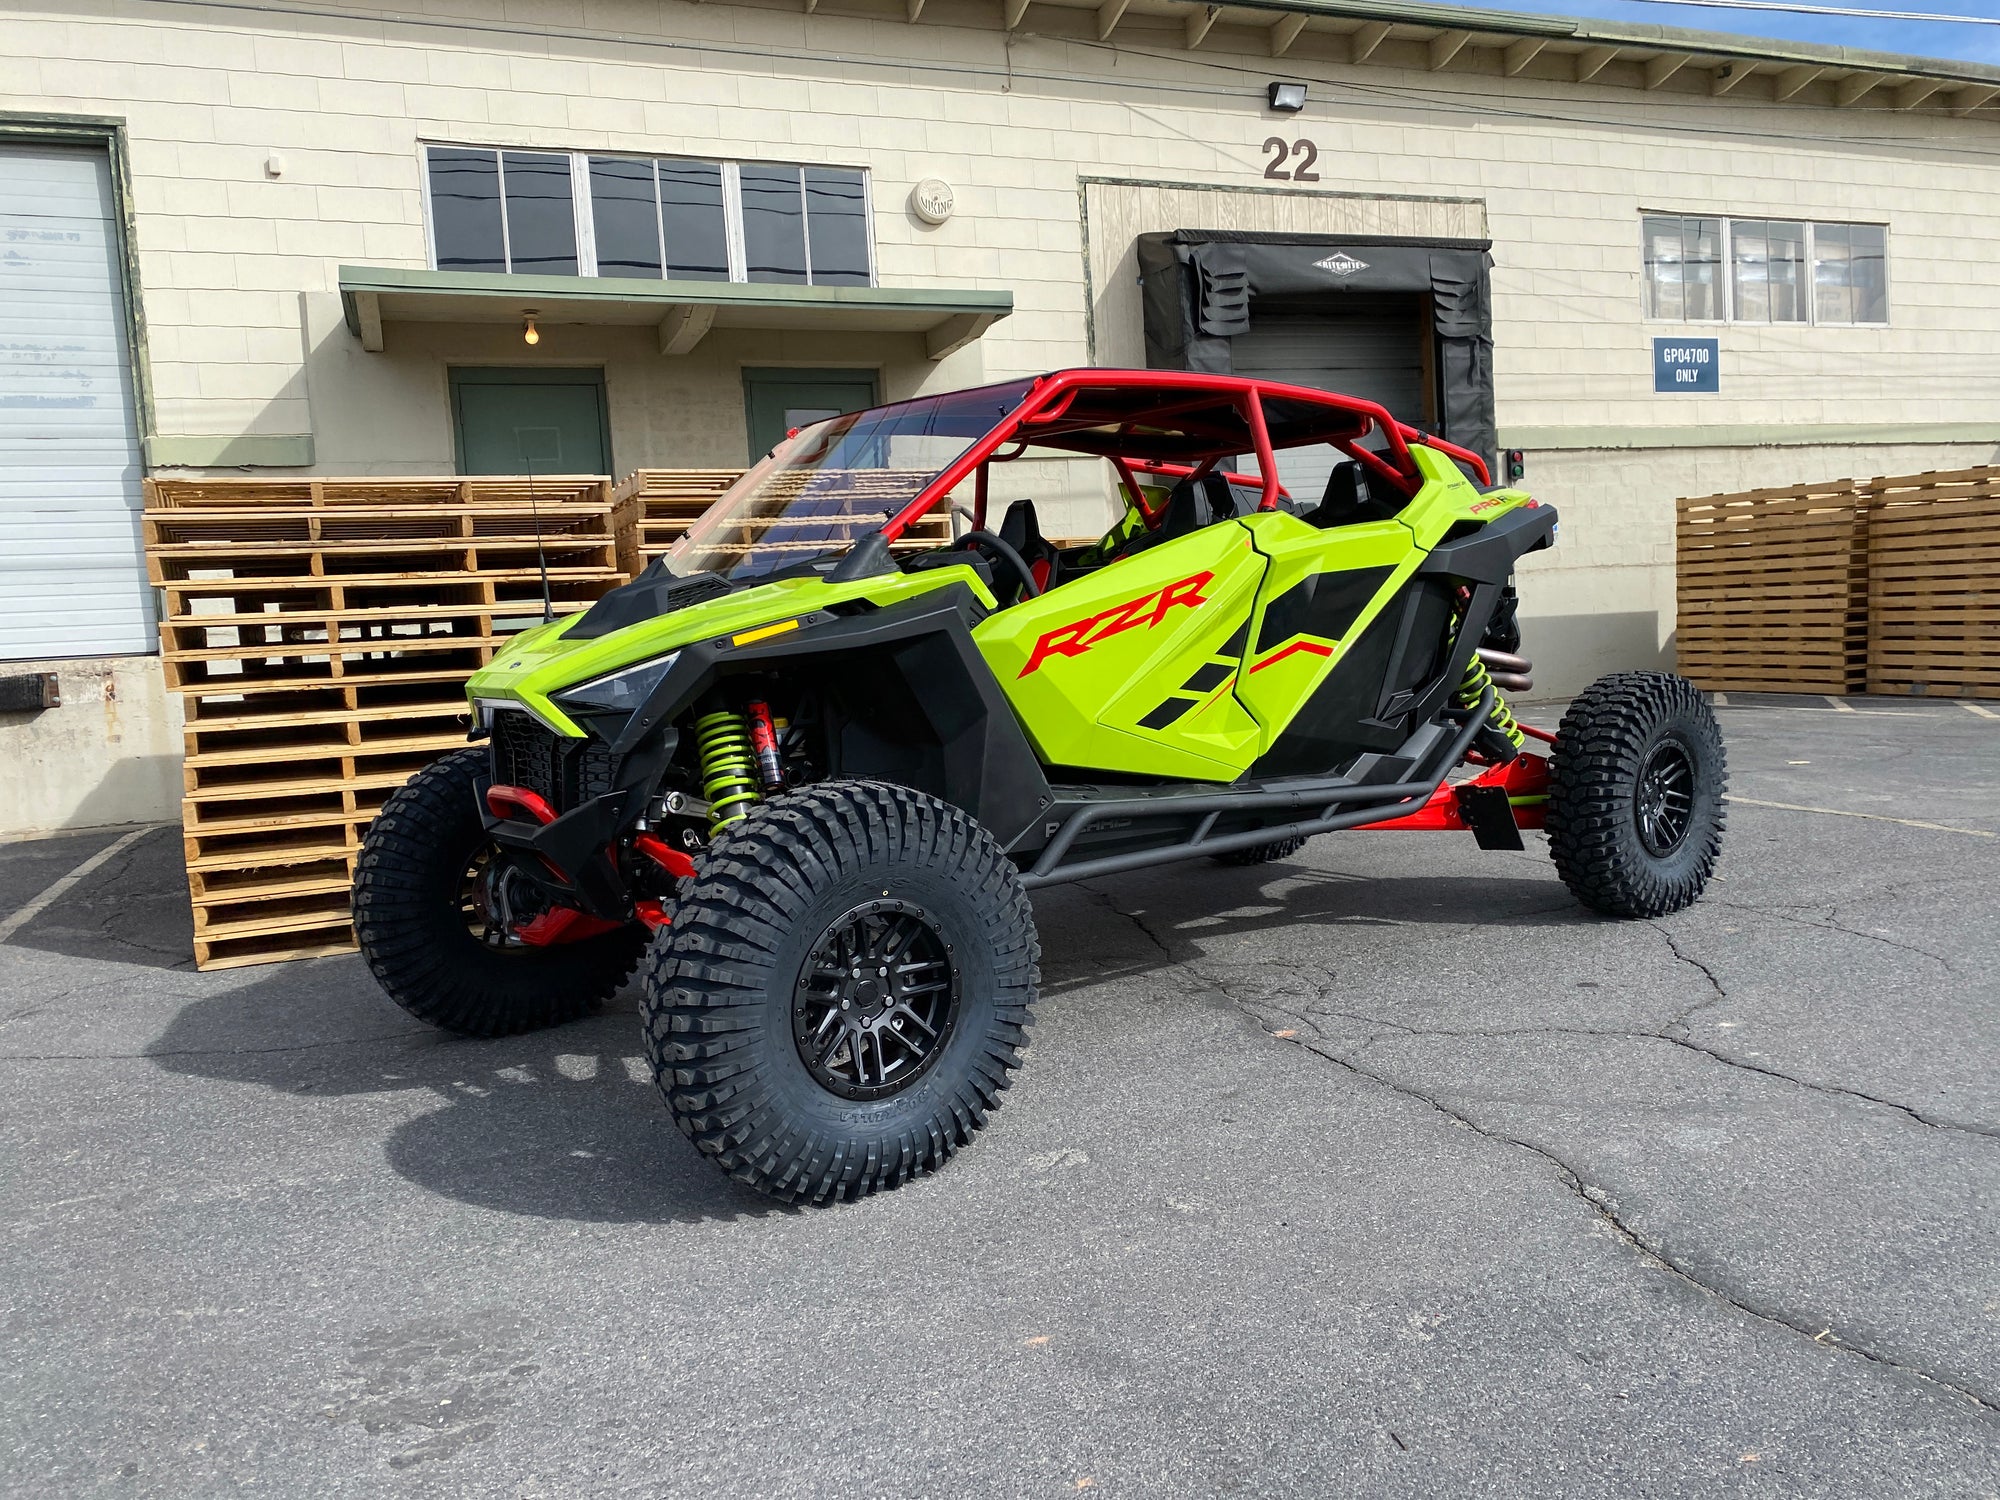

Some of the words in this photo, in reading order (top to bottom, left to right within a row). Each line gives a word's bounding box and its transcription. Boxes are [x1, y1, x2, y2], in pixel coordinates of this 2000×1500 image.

[1262, 136, 1320, 182] 22
[920, 195, 953, 215] VIKING
[1675, 368, 1699, 383] ONLY
[1469, 498, 1501, 515] PRO
[1016, 570, 1216, 680] RZR
